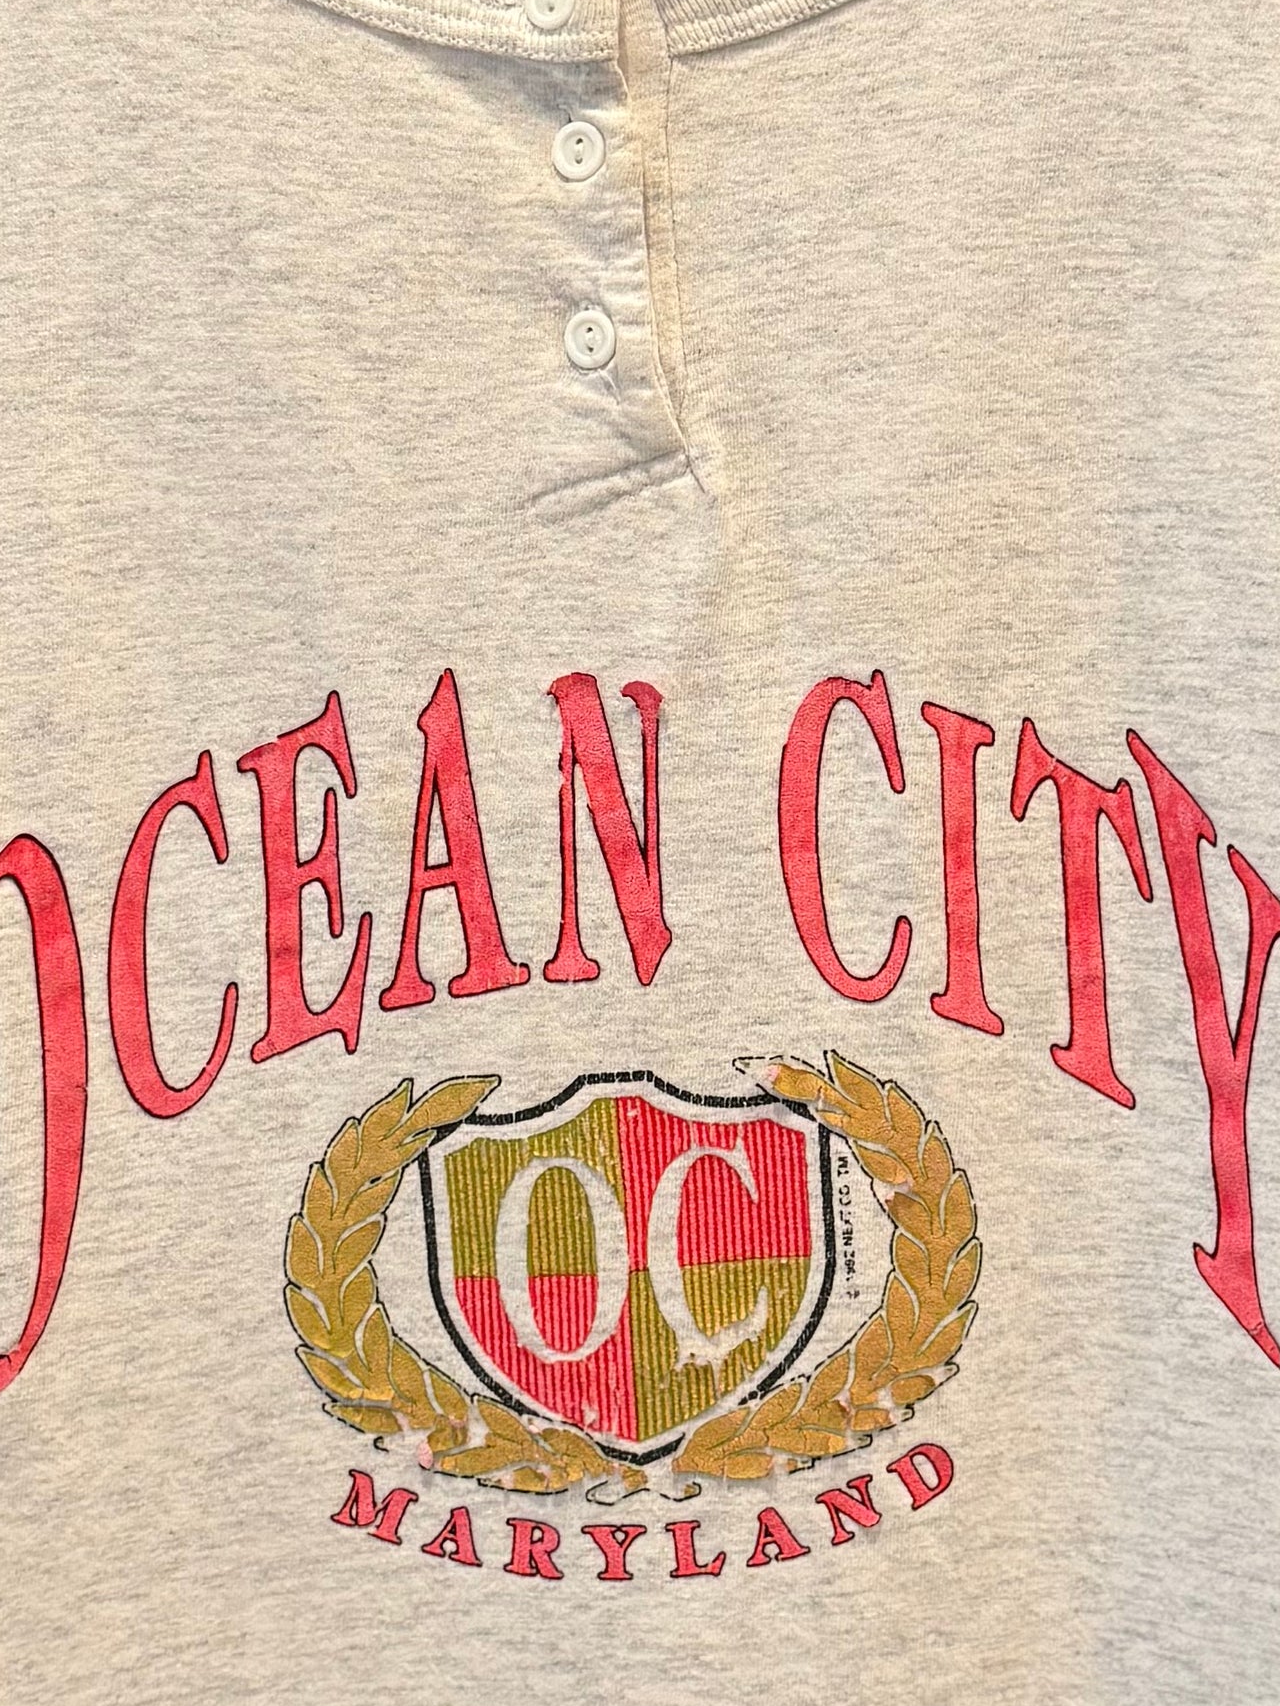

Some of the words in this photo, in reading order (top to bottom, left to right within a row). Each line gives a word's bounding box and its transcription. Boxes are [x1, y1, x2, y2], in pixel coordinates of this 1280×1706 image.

[837, 1155, 850, 1178] TM
[494, 1136, 769, 1364] OC
[331, 1442, 955, 1581] MARYLAND
